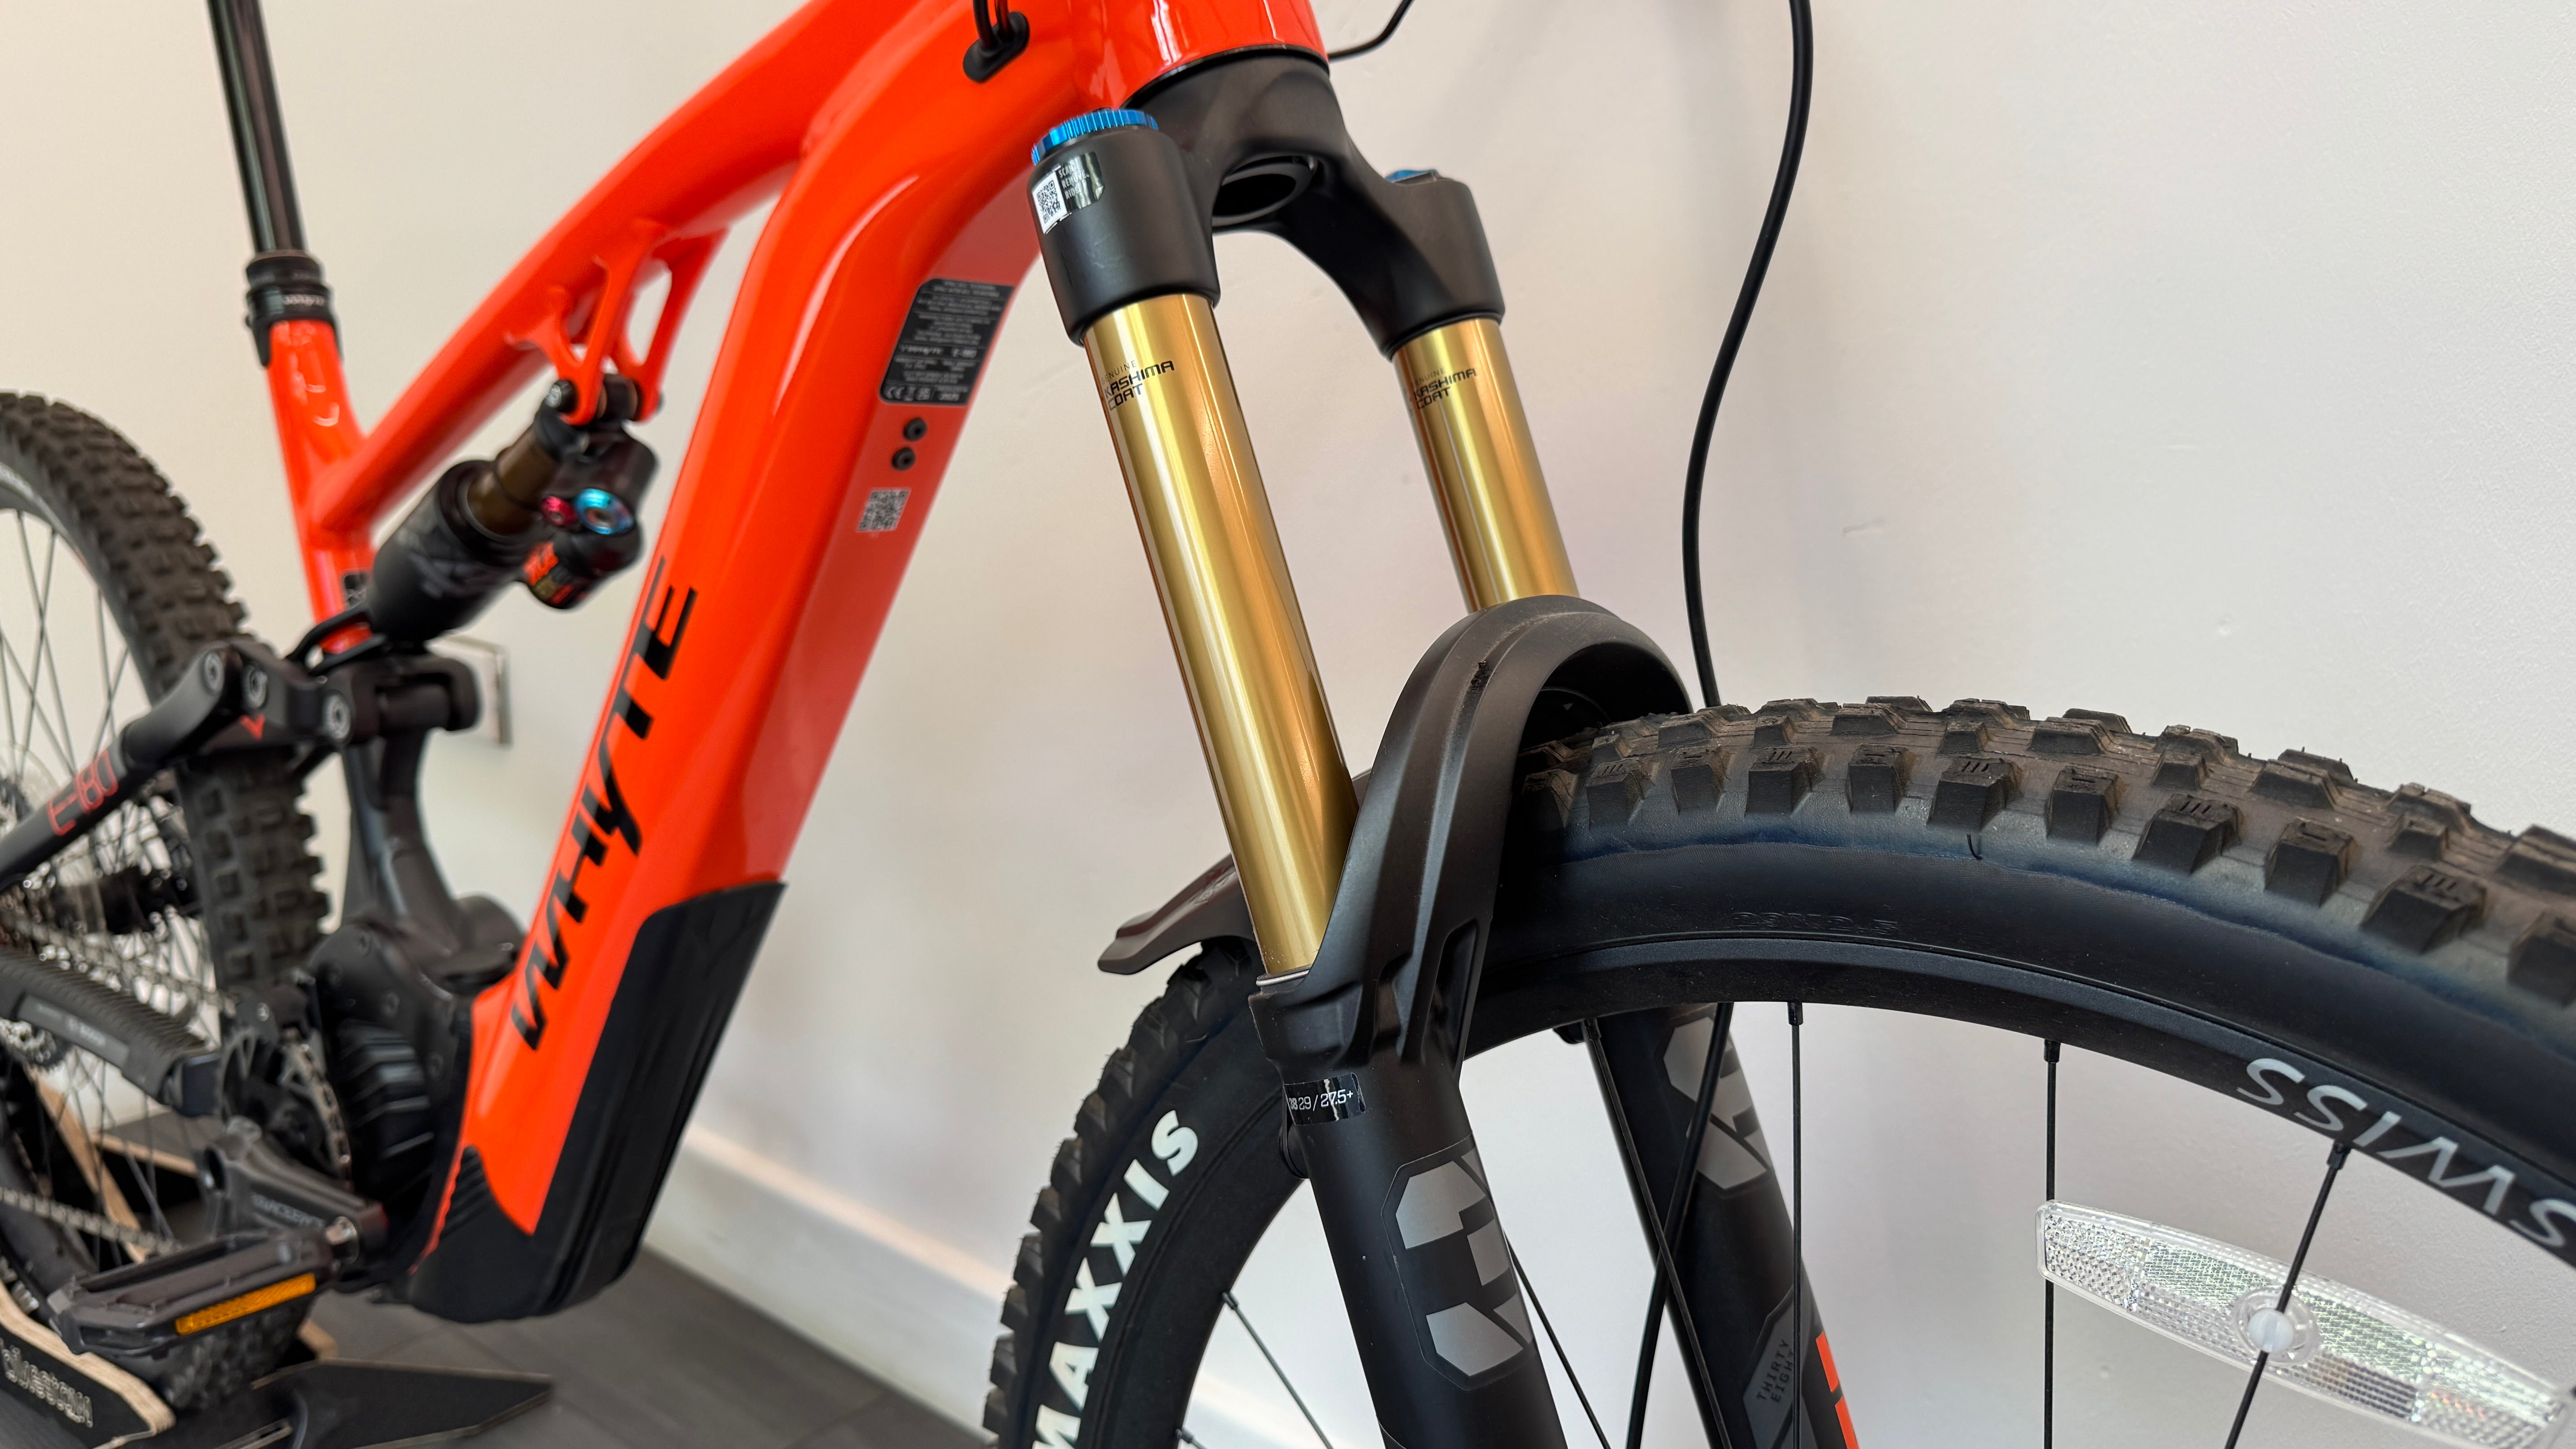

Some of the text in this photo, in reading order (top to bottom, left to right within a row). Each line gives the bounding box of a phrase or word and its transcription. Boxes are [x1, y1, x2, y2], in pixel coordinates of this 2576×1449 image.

[1104, 360, 1174, 399] KASHIMA
[1108, 383, 1142, 411] COAT
[1414, 368, 1477, 400] KASHIMA
[1417, 386, 1450, 410] COAT
[511, 555, 698, 1053] WHYTE
[1298, 1096, 1311, 1110] 29
[1320, 1089, 1353, 1107] 27.5+
[2236, 1058, 2576, 1247] SWISS
[1756, 1339, 1789, 1400] THIRTY
